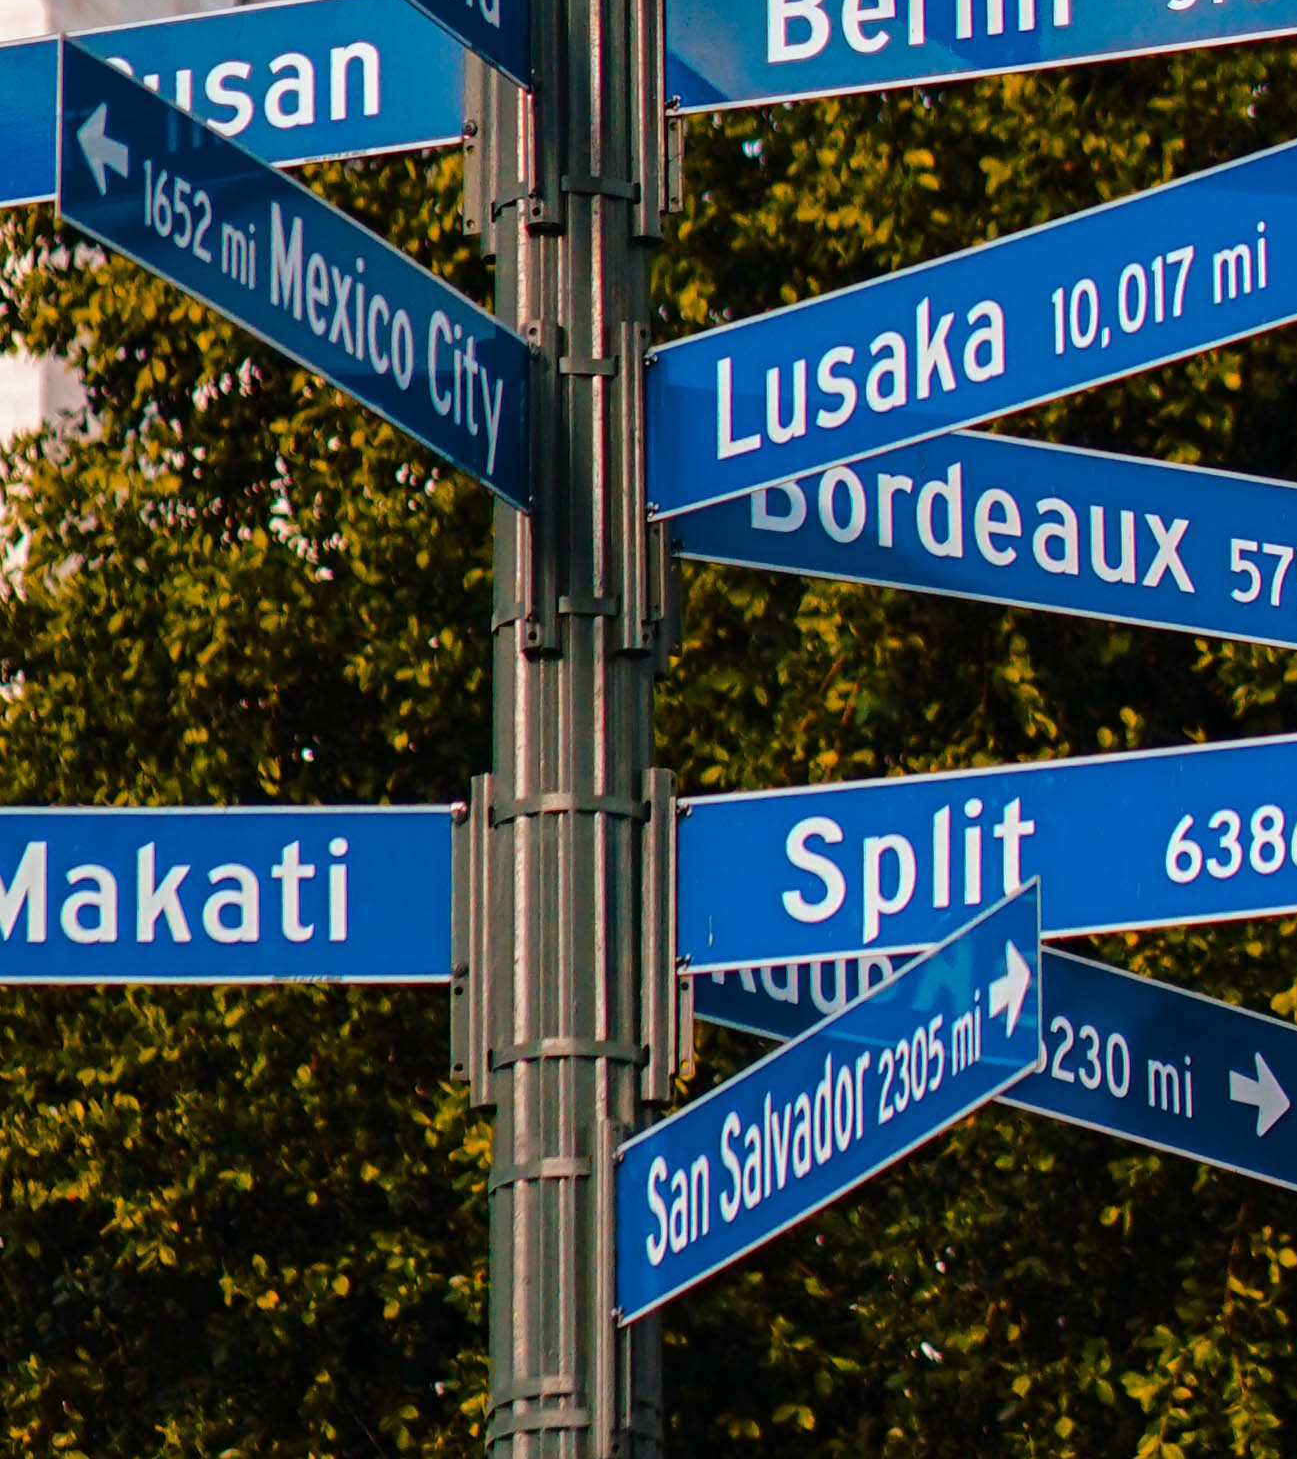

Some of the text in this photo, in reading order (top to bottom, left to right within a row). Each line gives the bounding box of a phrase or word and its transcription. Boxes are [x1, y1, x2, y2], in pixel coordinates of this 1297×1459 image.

[144, 160, 504, 475] 1652 mi Mexico City
[717, 221, 1267, 460] Lusaka 10,017 mi
[751, 463, 1195, 594] Bordeaux
[783, 796, 1035, 944] Split
[647, 990, 982, 1267] San Salvador 2305 mi
[1038, 1016, 1193, 1118] 230 mi
